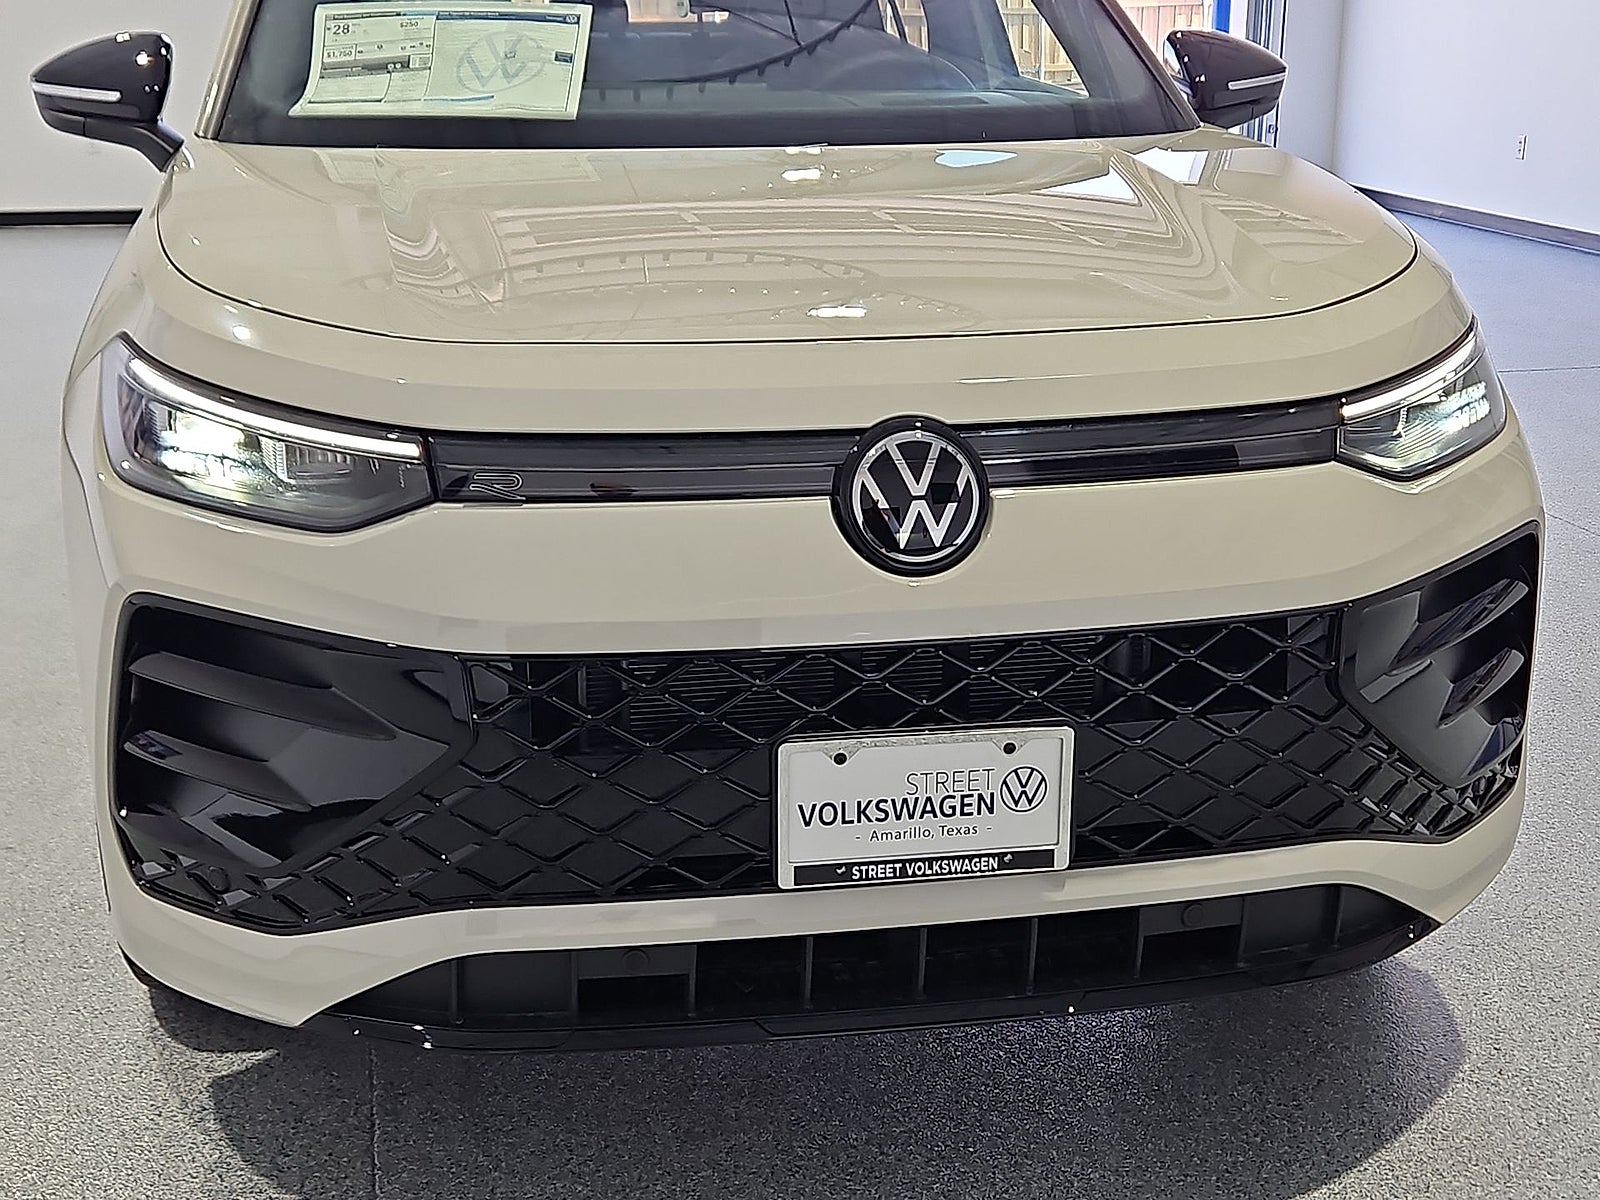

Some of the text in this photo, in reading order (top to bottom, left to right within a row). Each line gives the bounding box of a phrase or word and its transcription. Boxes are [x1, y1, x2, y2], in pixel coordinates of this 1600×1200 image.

[332, 24, 351, 35] 28
[906, 768, 996, 795] STREET
[797, 792, 996, 827] VOLKSWAGEN
[869, 825, 935, 842] Amarillo,
[938, 824, 978, 837] Texas
[852, 857, 999, 880] STREET VOLKSWAGEN
